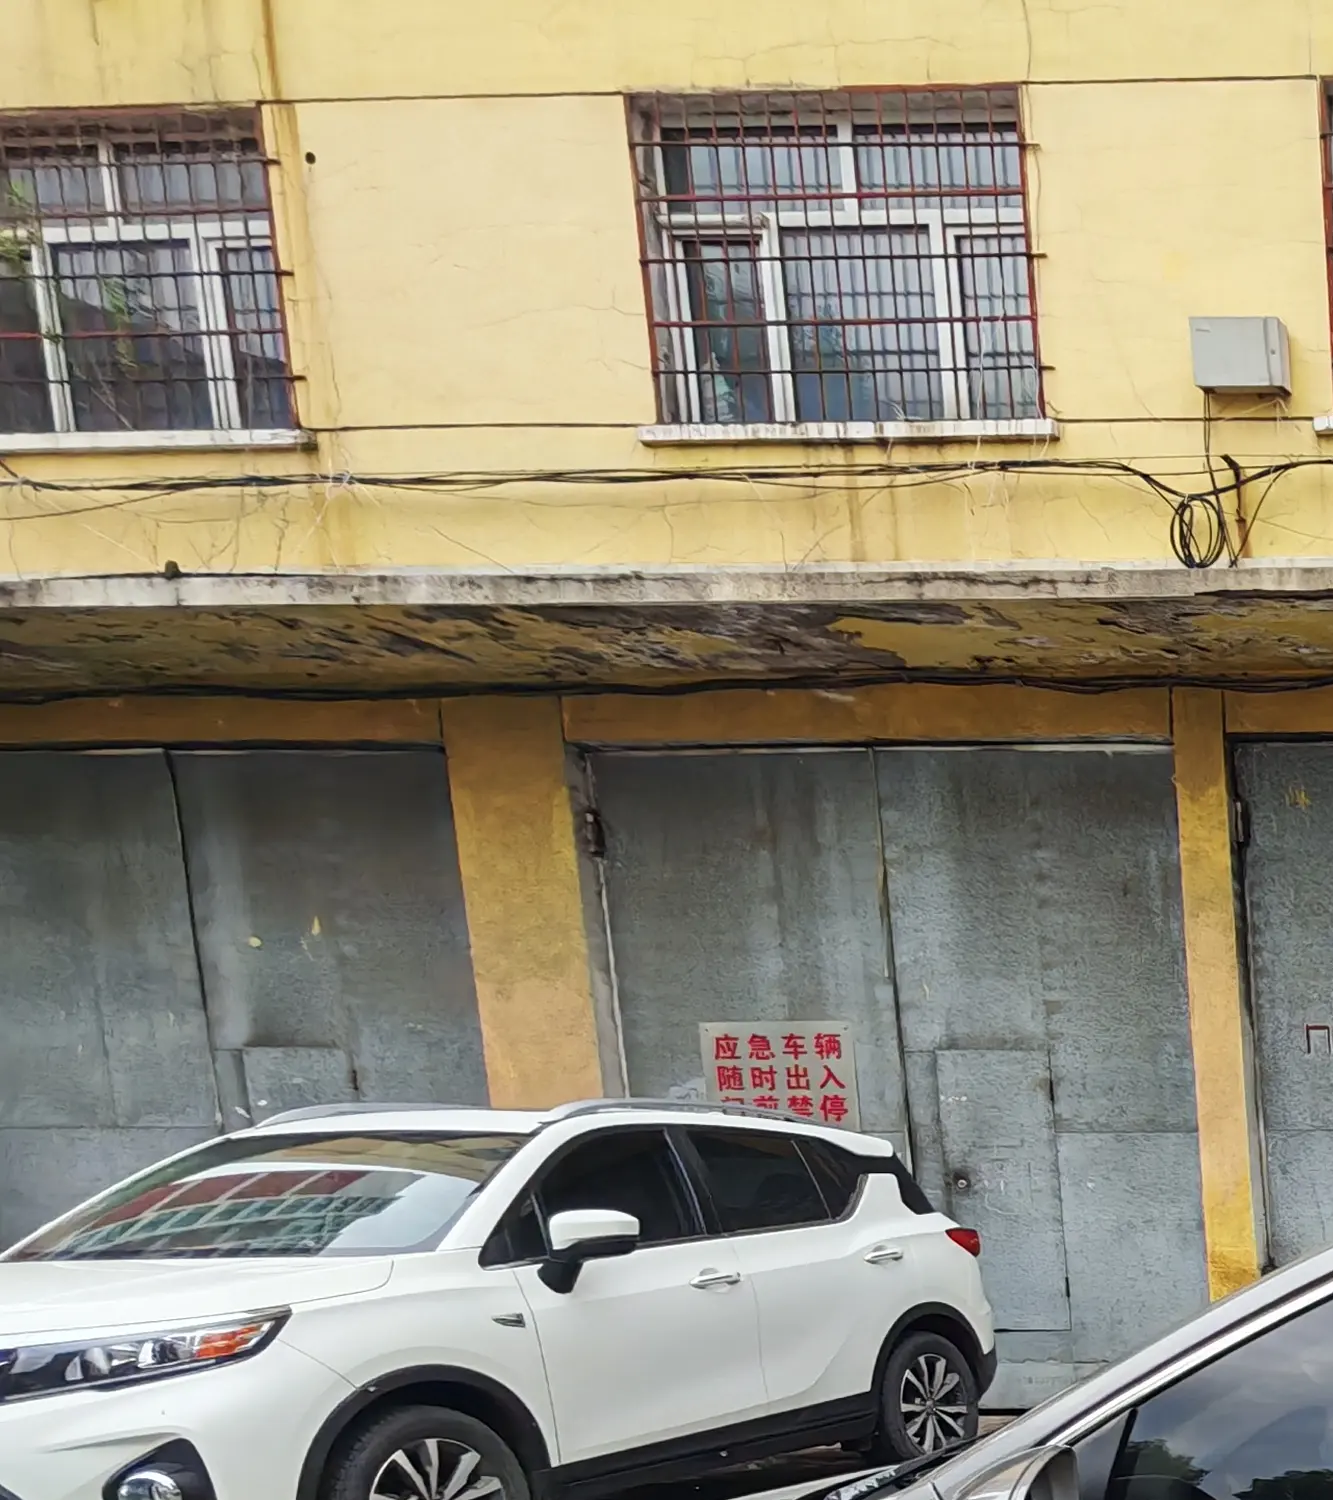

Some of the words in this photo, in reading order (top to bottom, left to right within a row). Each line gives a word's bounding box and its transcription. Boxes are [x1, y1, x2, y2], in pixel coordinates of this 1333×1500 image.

[714, 1032, 842, 1061] 应急车辆
[715, 1064, 846, 1092] 随时出入
[720, 1094, 849, 1122] 禁停
